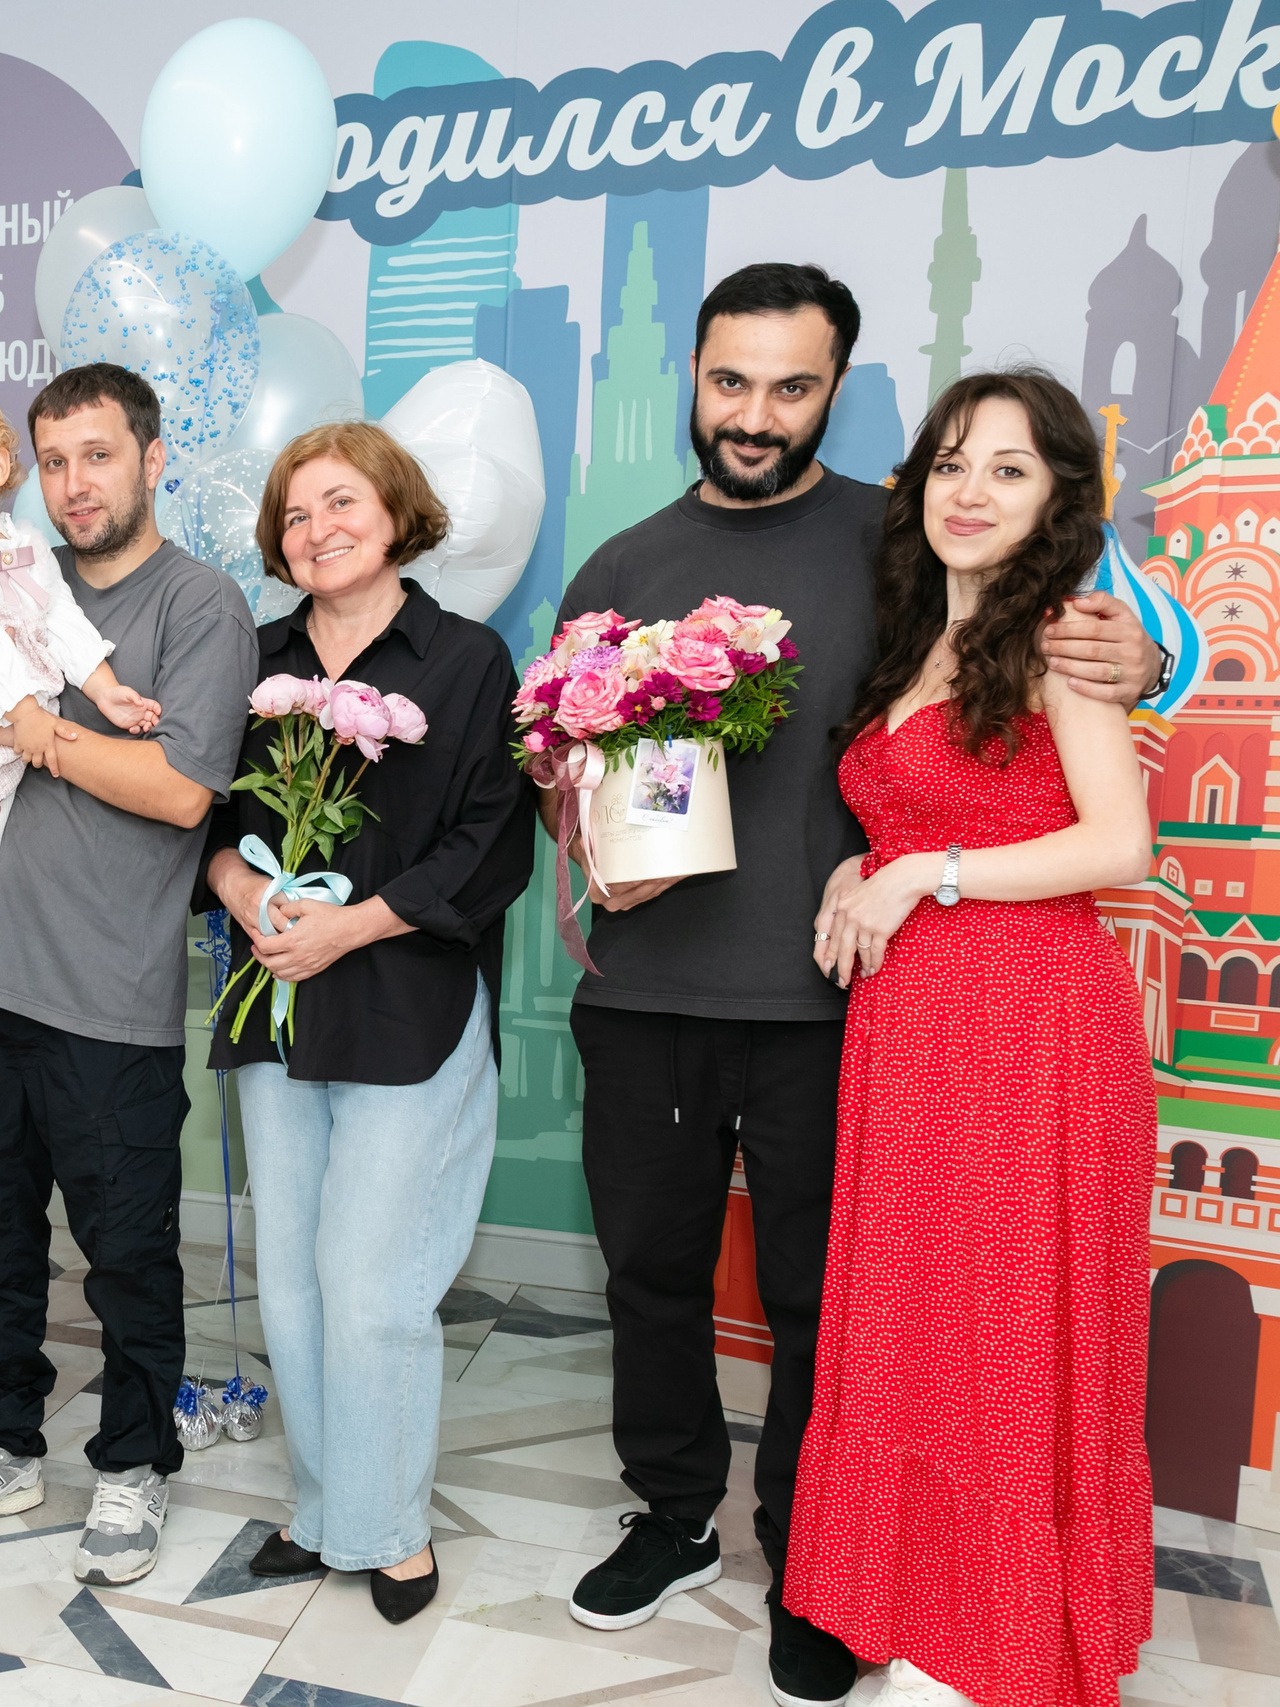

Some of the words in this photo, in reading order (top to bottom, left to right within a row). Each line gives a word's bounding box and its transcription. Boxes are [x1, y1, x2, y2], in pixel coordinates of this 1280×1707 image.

[326, 81, 772, 219] одился
[795, 26, 884, 149] в
[904, 0, 1280, 147] Моск
